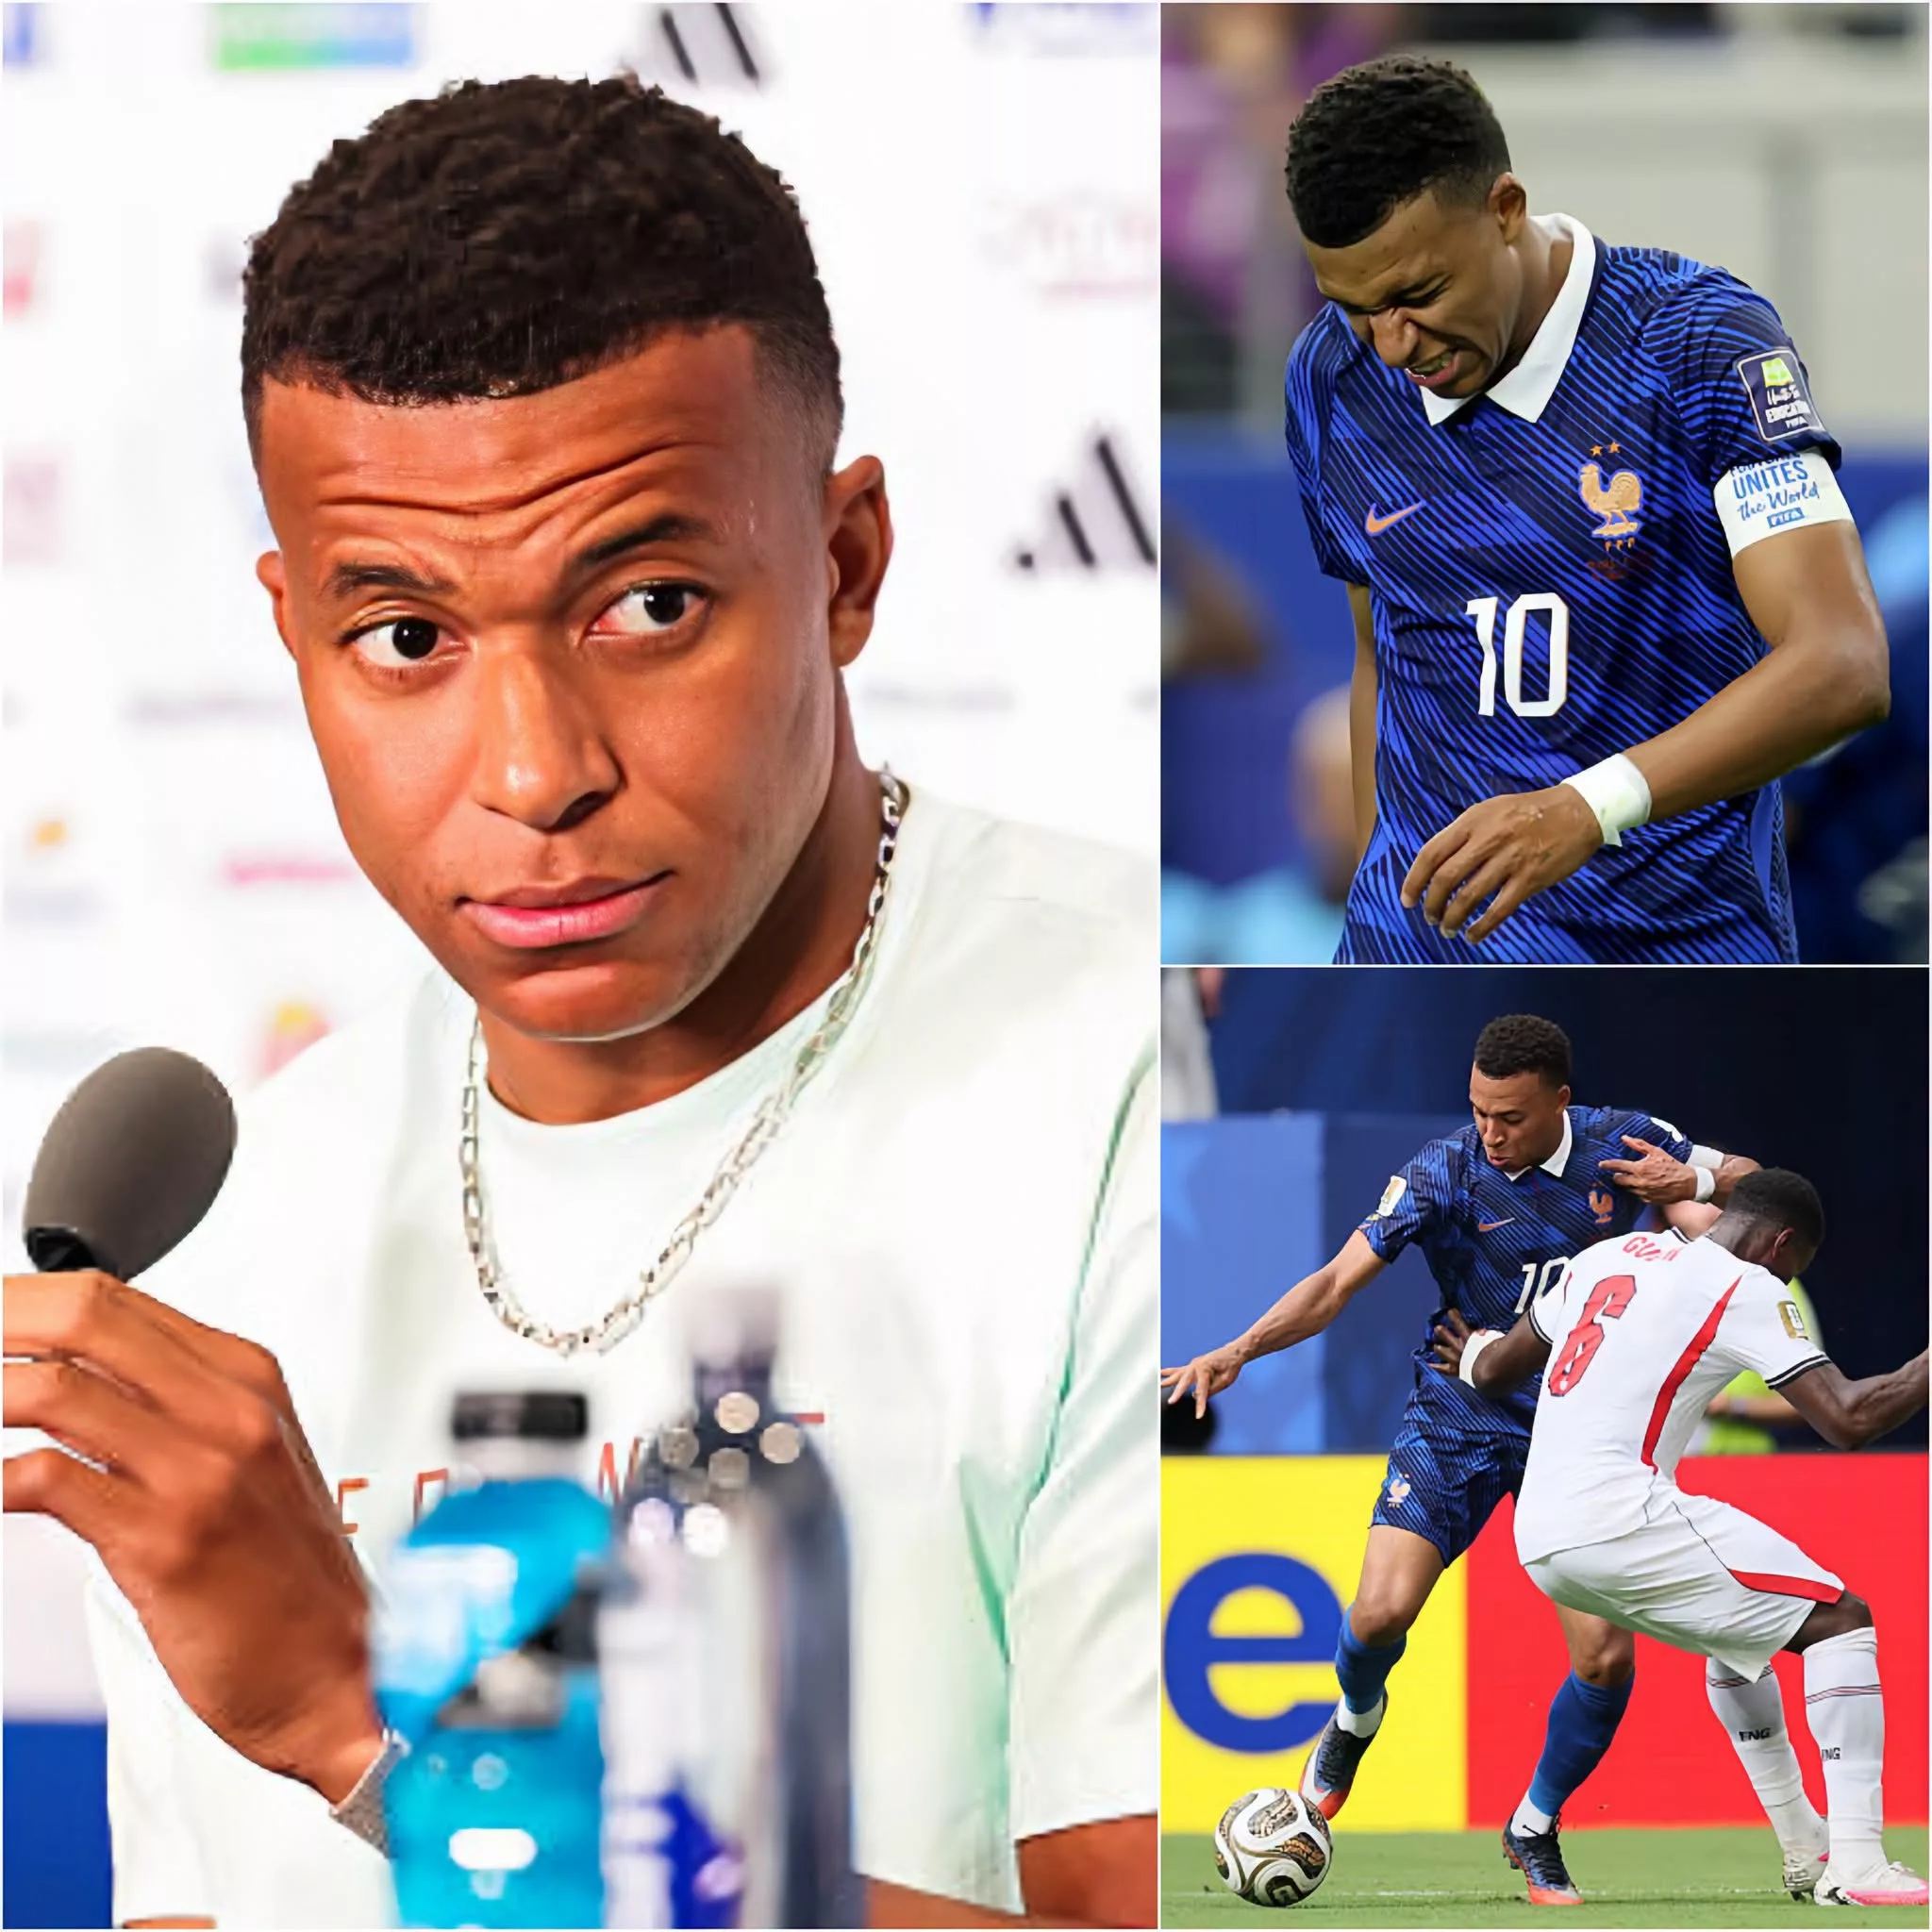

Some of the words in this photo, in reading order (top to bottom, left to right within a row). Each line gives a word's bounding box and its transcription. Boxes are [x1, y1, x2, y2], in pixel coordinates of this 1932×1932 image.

[1733, 460, 1808, 499] UNITES
[1738, 502, 1766, 521] the
[1767, 482, 1820, 509] World
[1465, 592, 1569, 717] 10
[1514, 1257, 1570, 1313] 10
[1549, 1274, 1637, 1396] 6
[1163, 1552, 1343, 1754] e
